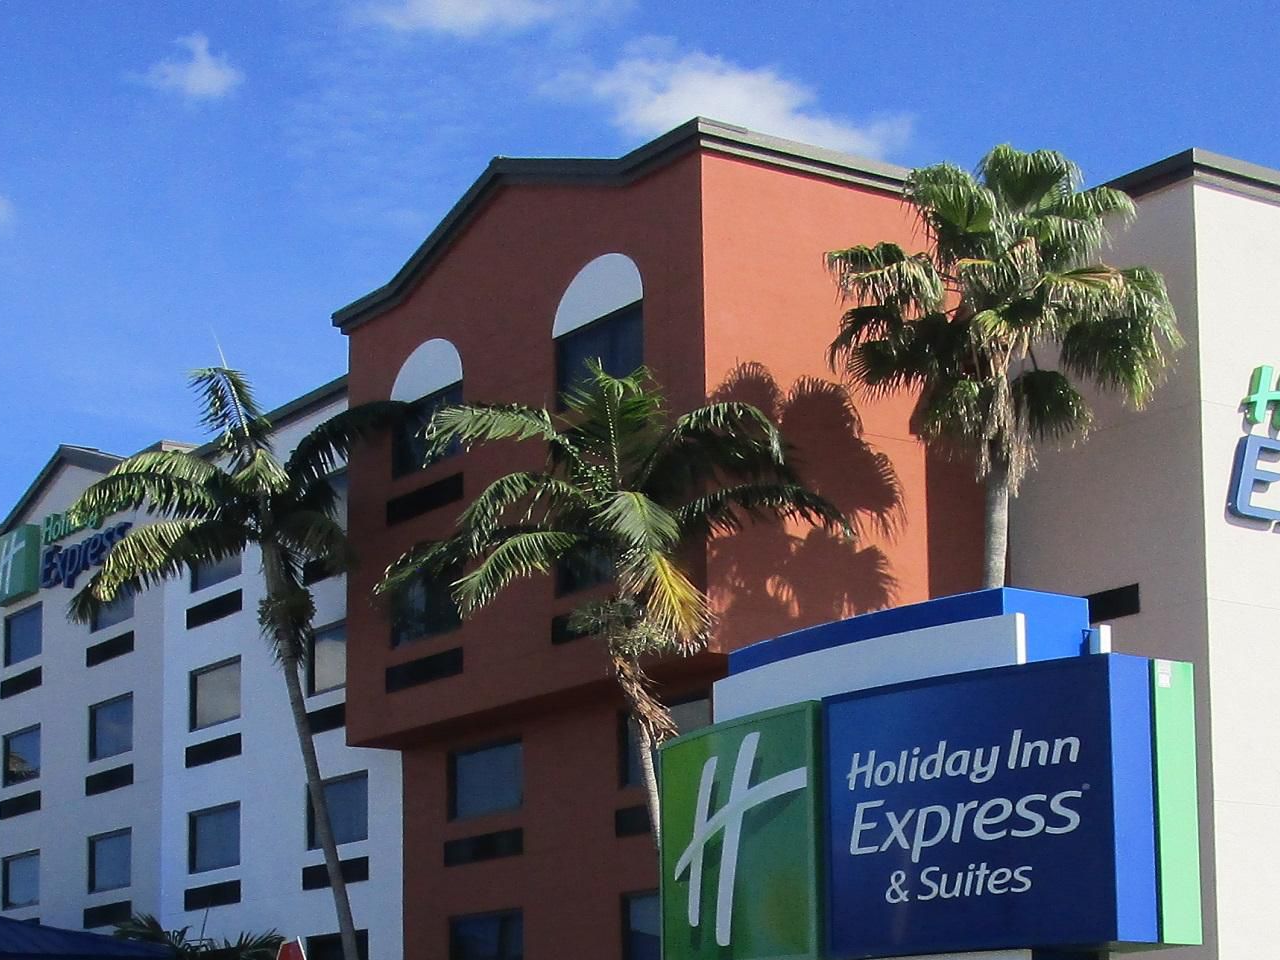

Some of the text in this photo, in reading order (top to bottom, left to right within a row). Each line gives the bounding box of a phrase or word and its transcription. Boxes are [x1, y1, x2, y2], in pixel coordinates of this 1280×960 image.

[847, 728, 1082, 791] Holiday Inn
[674, 731, 808, 947] H
[849, 789, 1083, 863] Express
[885, 862, 1033, 904] & Suites
